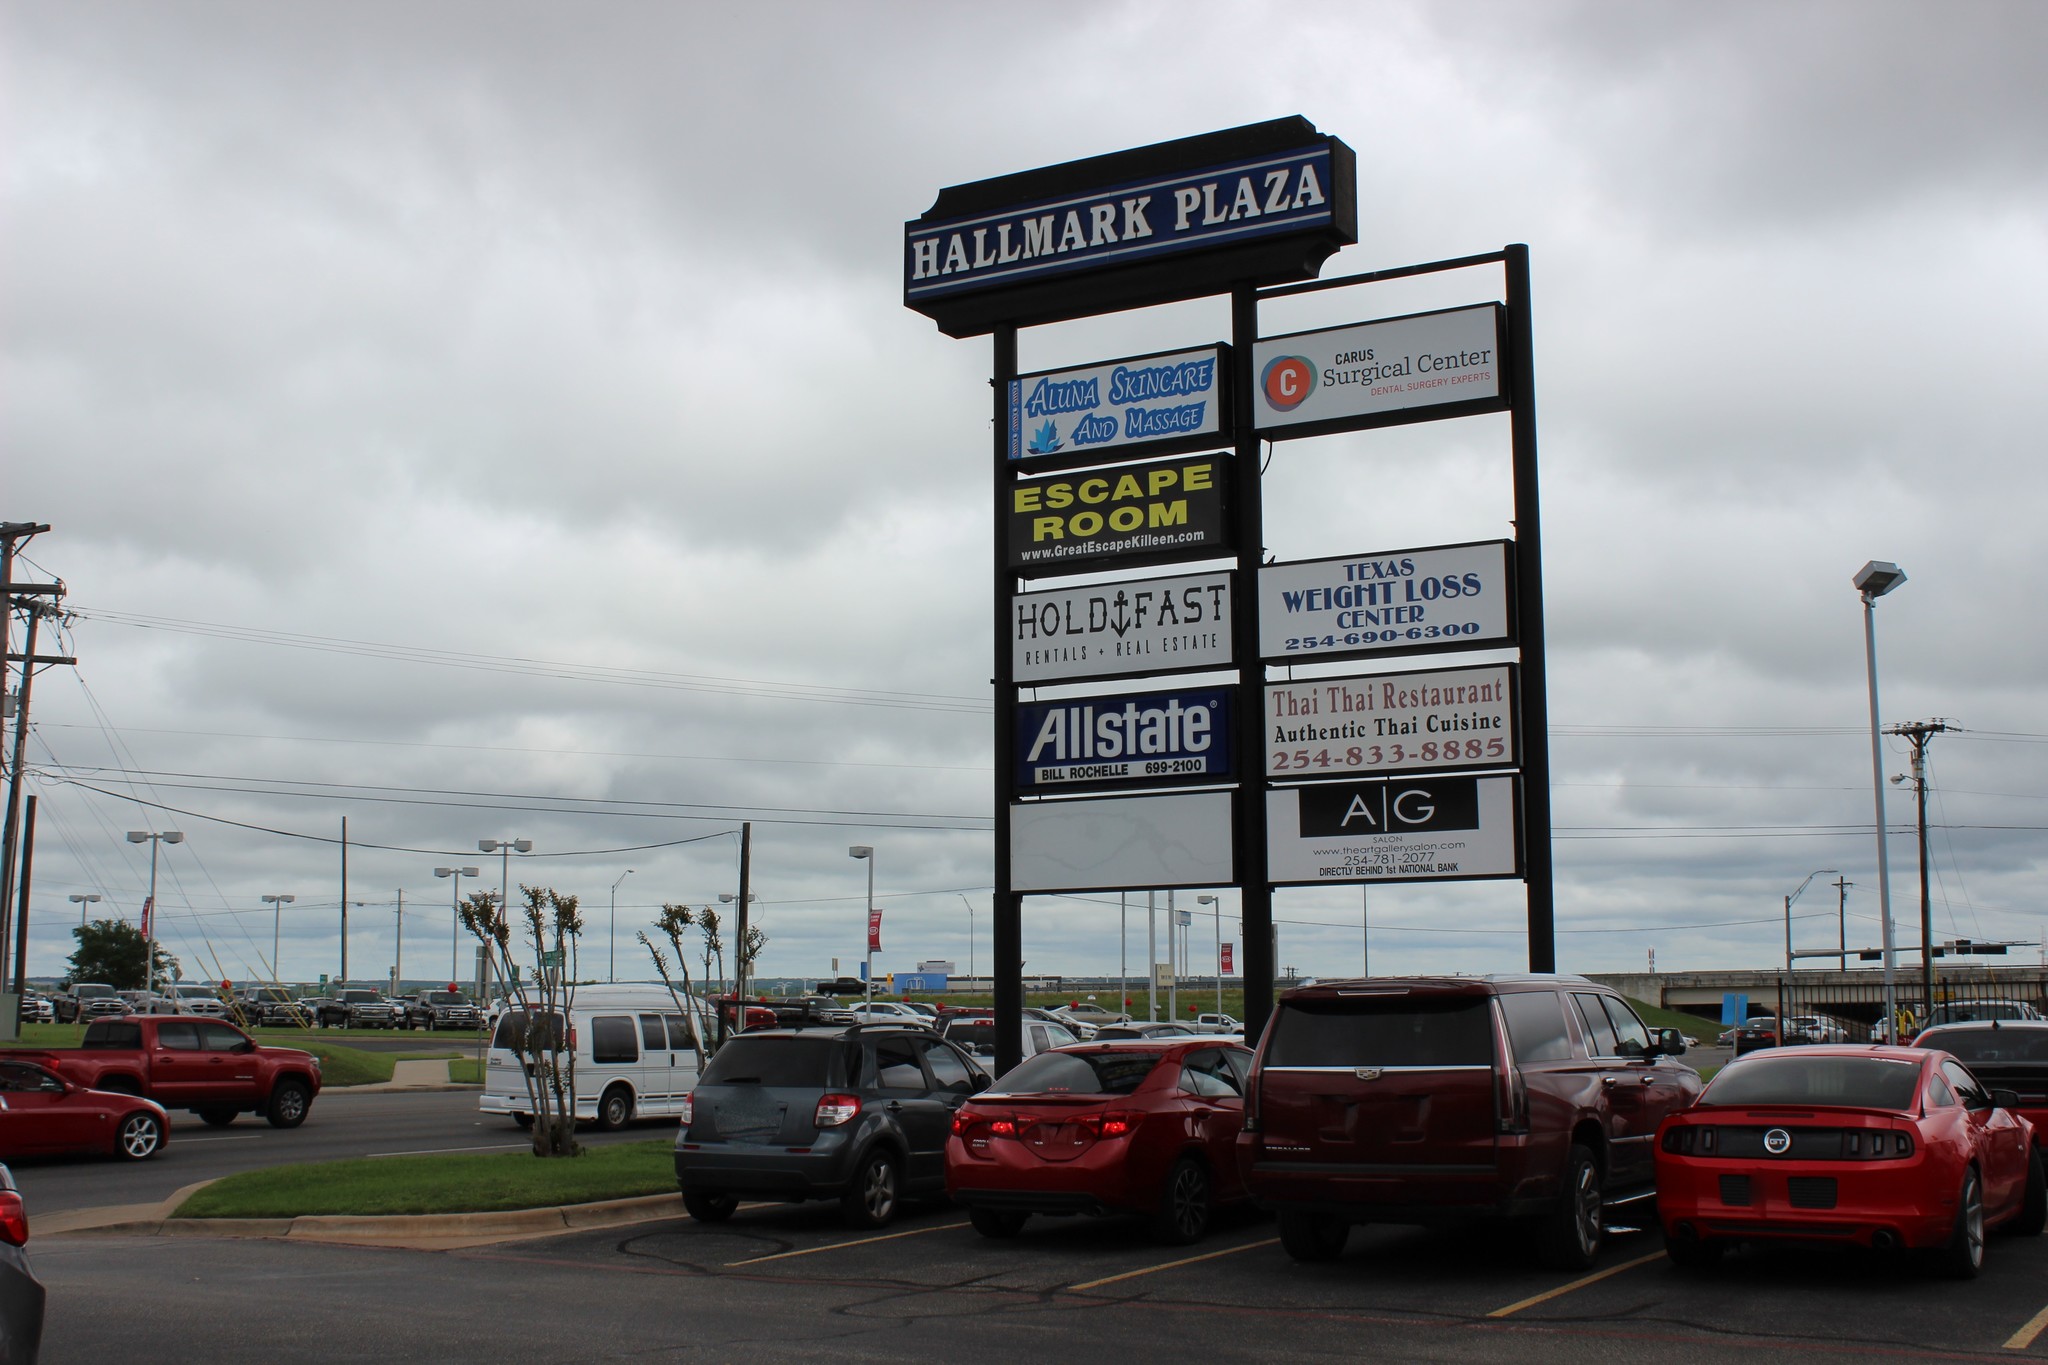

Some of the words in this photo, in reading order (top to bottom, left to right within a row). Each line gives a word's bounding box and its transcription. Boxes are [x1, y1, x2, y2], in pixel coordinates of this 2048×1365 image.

[912, 196, 1152, 280] HALLMARK
[1174, 164, 1325, 231] PLAZA
[1323, 356, 1410, 387] Surgical
[1417, 350, 1491, 373] Center
[1335, 349, 1374, 365] CARUS
[1371, 385, 1404, 396] DENTAL
[1407, 378, 1448, 391] SURGERY
[1451, 372, 1491, 385] EXPERTS
[1014, 464, 1213, 513] ESCAPE
[1033, 499, 1187, 542] ROOM
[1021, 531, 1204, 561] www.GreatEscapeKilleen.com
[1343, 558, 1415, 582] TEXAS
[1282, 581, 1396, 613] WEIGHT
[1405, 573, 1482, 602] LOSS
[1018, 597, 1107, 639] HOLD
[1135, 585, 1225, 628] FAST
[1336, 605, 1424, 629] CENTER
[1026, 646, 1087, 665] RENTALS
[1116, 640, 1150, 656] REAL
[1163, 633, 1217, 652] ESTATE
[1285, 622, 1480, 650] 254-690-6300
[1273, 688, 1318, 717] Thai
[1327, 684, 1373, 713] Thai
[1382, 677, 1503, 710] Restaurant
[1274, 720, 1366, 743] Authentic
[1374, 716, 1417, 736] Thai
[1426, 712, 1502, 732] Cuisine
[1273, 737, 1505, 771] 254-833-8885
[1042, 769, 1065, 781] BILL
[1069, 764, 1129, 779] ROCHELLE
[1145, 759, 1202, 774] 699-2100
[1313, 841, 1465, 856] www.theartgallerysalon.com
[1372, 835, 1403, 844] SALON
[1319, 866, 1353, 877] DIRECTLY
[1356, 865, 1383, 876] BEHIND
[1386, 865, 1396, 875] 1st
[1398, 863, 1435, 875] NATIONAL
[1437, 862, 1459, 872] BANK
[1344, 852, 1435, 866] 254-781-2077
